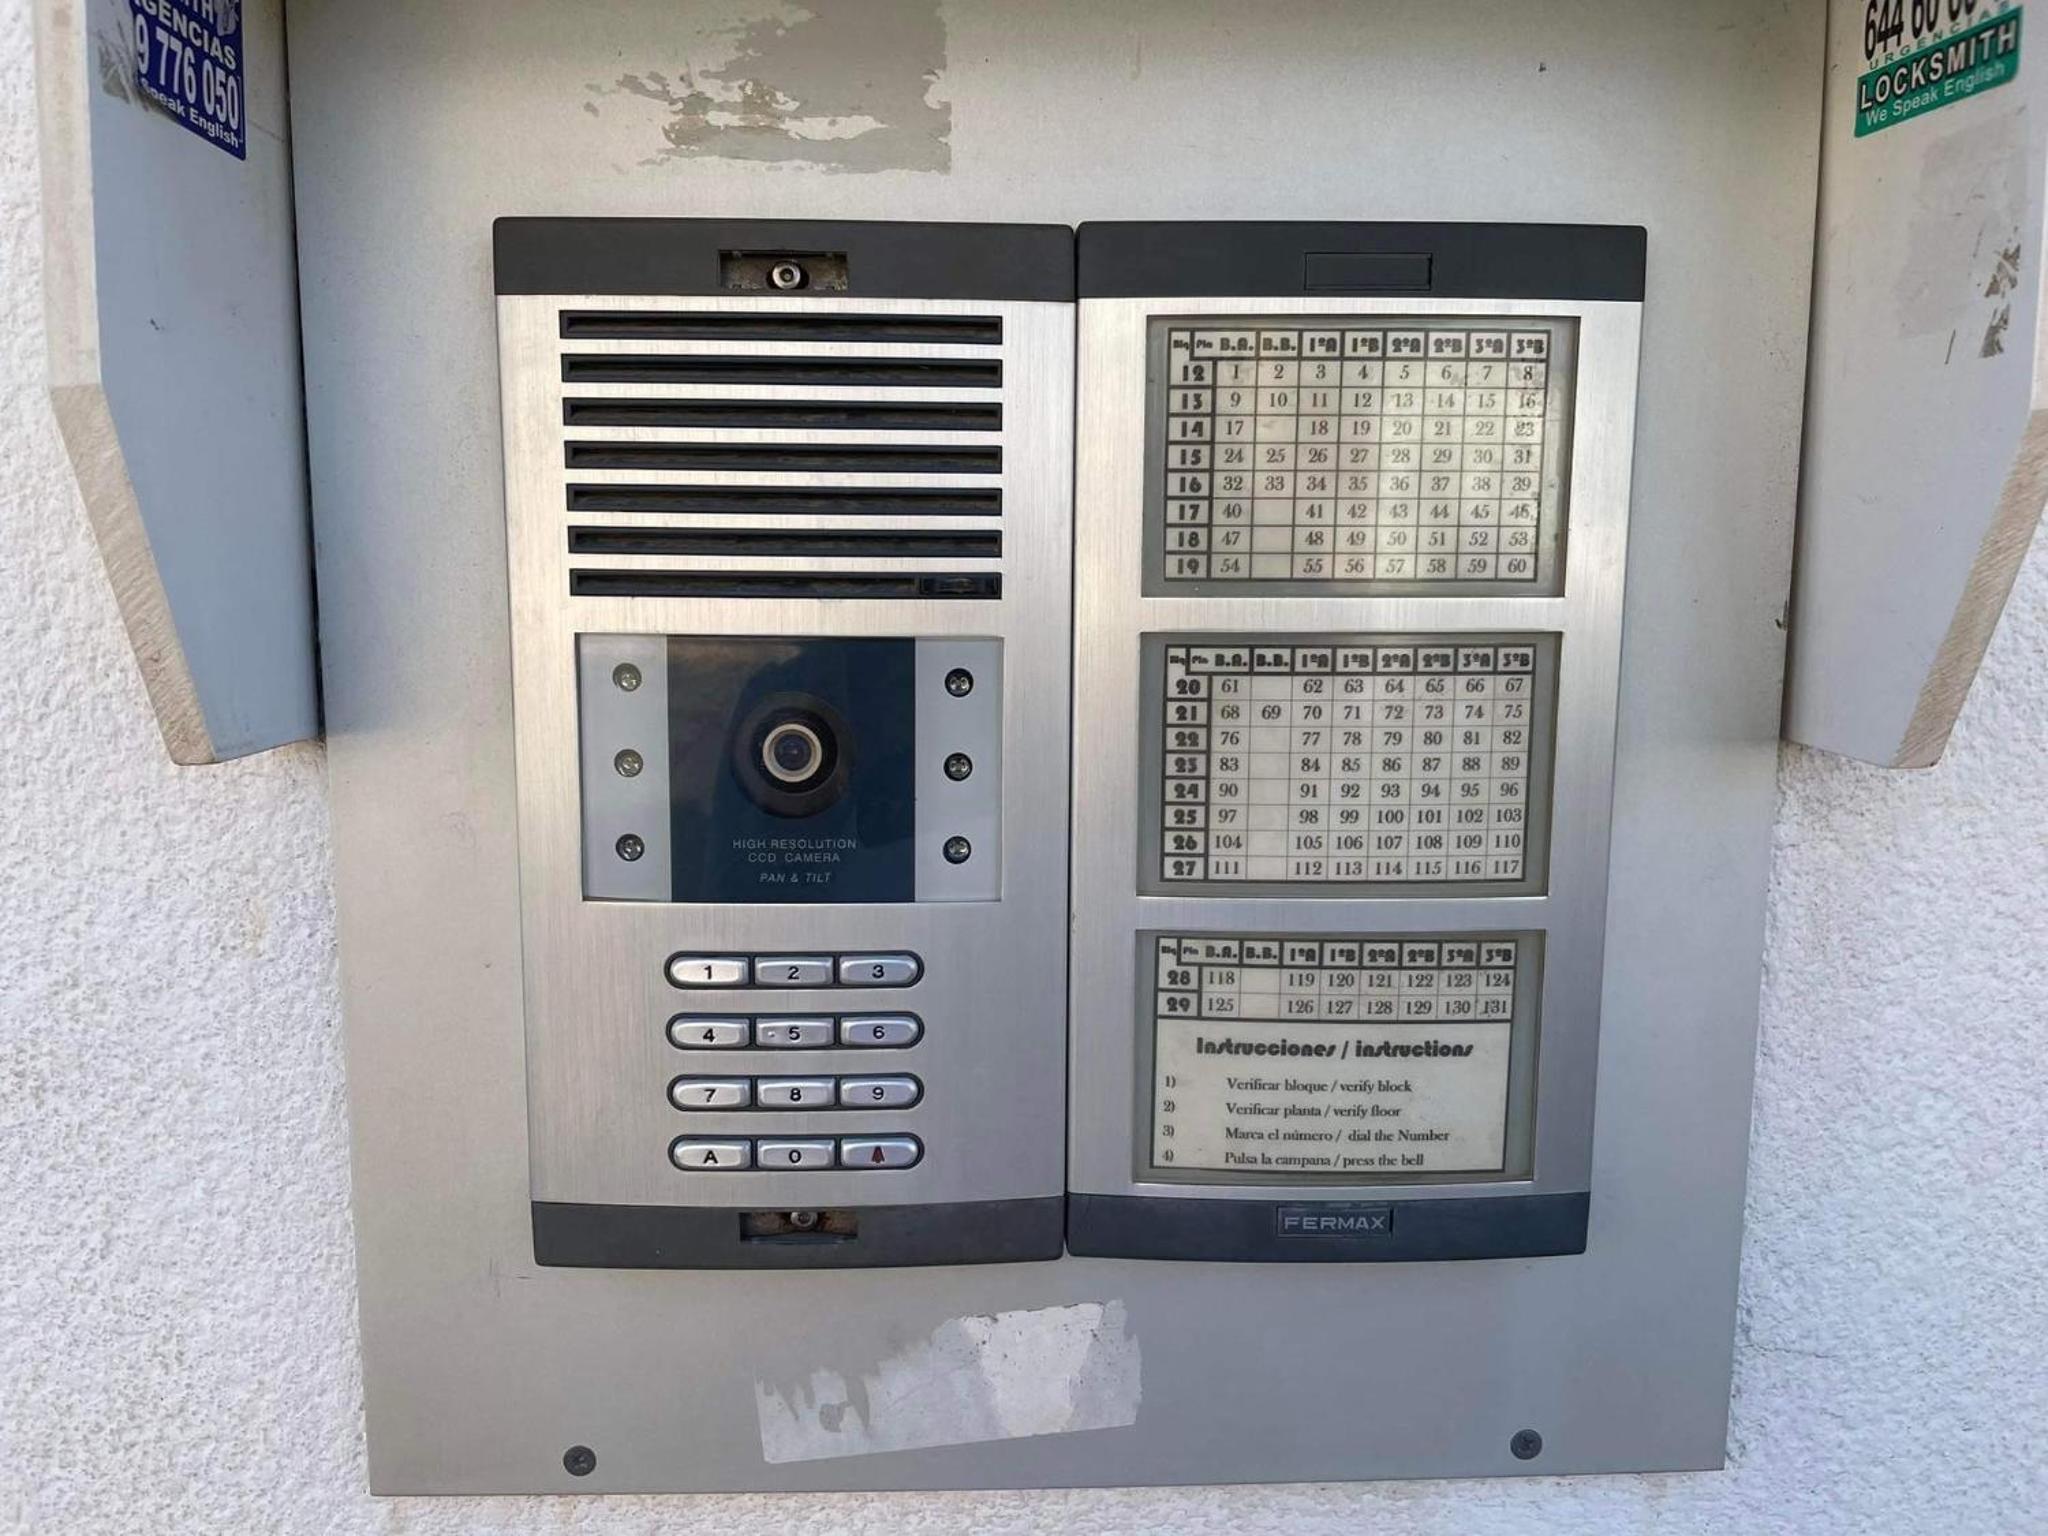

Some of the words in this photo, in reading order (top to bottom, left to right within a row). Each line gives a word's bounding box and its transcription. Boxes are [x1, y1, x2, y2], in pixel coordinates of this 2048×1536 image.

[136, 0, 236, 70] GENCIAS
[1860, 18, 2018, 110] LOCKSMITH
[155, 26, 197, 103] 776
[202, 60, 240, 131] 050
[1866, 109, 1888, 127] We
[1892, 90, 1939, 117] Speak
[1943, 61, 2006, 97] English
[190, 110, 239, 149] English
[1180, 448, 1202, 466] 15
[1223, 447, 1245, 464] 24
[1266, 447, 1286, 464] 25
[1308, 447, 1328, 464] 26
[1349, 447, 1369, 464] 27
[1391, 447, 1411, 464] 28
[1431, 447, 1453, 464] 29
[1513, 448, 1533, 465] 31
[1179, 476, 1203, 494] 16
[1222, 475, 1244, 491] 32
[1264, 475, 1285, 491] 33
[1306, 475, 1327, 491] 34
[1347, 475, 1369, 492] 35
[1389, 475, 1411, 492] 36
[1430, 475, 1451, 492] 37
[1177, 557, 1200, 575] 19
[1219, 557, 1241, 573] 54
[1302, 557, 1323, 574] 55
[1344, 557, 1365, 574] 56
[1385, 558, 1406, 575] 57
[1426, 557, 1447, 574] 58
[1467, 558, 1488, 574] 59
[1507, 557, 1527, 574] 60
[1175, 678, 1201, 696] 20
[1221, 678, 1239, 693] 61
[1303, 678, 1324, 694] 62
[1343, 677, 1364, 694] 63
[1384, 677, 1405, 694] 64
[1425, 677, 1445, 694] 65
[1465, 677, 1485, 693] 66
[1505, 677, 1524, 693] 67
[1175, 705, 1197, 722] 21
[1220, 703, 1241, 720] 68
[1261, 704, 1282, 720] 69
[1303, 705, 1323, 720] 70
[1343, 705, 1361, 721] 71
[1384, 704, 1405, 720] 72
[1424, 704, 1444, 720] 73
[1464, 704, 1485, 719] 74
[1504, 703, 1523, 719] 75
[1173, 808, 1197, 825] 25
[1218, 808, 1237, 824] 97
[1299, 809, 1319, 824] 98
[1339, 809, 1360, 825] 99
[1377, 809, 1405, 825] 100
[1417, 809, 1442, 824] 101
[1457, 808, 1484, 824] 102
[1496, 807, 1523, 823] 103
[732, 839, 766, 849] HIGH
[770, 839, 857, 849] RESOLUTION
[1172, 834, 1198, 851] 26
[1215, 834, 1243, 849] 104
[1295, 835, 1323, 850] 105
[1336, 835, 1364, 850] 106
[1377, 835, 1403, 850] 107
[1416, 834, 1443, 850] 108
[1456, 834, 1483, 849] 109
[1495, 833, 1521, 849] 110
[748, 852, 777, 863] CCD
[784, 852, 841, 863] CAMERA
[1172, 859, 1197, 877] 27
[1214, 860, 1239, 875] 111
[1295, 860, 1323, 876] 112
[1335, 861, 1363, 876] 113
[1375, 861, 1403, 876] 114
[1415, 861, 1442, 876] 115
[1455, 860, 1481, 875] 116
[1493, 859, 1520, 875] 117
[759, 872, 786, 883] PAN
[806, 872, 831, 883] TILT
[703, 965, 713, 980] 1
[787, 966, 800, 980] 2
[872, 965, 885, 979] 3
[1167, 969, 1191, 986] 28
[1209, 970, 1235, 985] 118
[1289, 972, 1316, 987] 119
[1328, 972, 1355, 988] 120
[1368, 973, 1392, 989] 121
[1407, 973, 1435, 988] 122
[1447, 973, 1473, 988] 123
[1485, 973, 1511, 987] 124
[1166, 996, 1191, 1013] 29
[1207, 997, 1234, 1013] 125
[1287, 999, 1314, 1015] 126
[1327, 999, 1353, 1015] 127
[1367, 1000, 1393, 1015] 128
[1406, 1000, 1433, 1015] 129
[1445, 1000, 1472, 1015] 130
[702, 1028, 715, 1043] 4
[789, 1027, 800, 1041] 5
[873, 1026, 885, 1039] 6
[1196, 1037, 1336, 1057] Instrucciones
[1341, 1040, 1349, 1060] /
[1355, 1040, 1474, 1057] instructions
[704, 1089, 716, 1103] 7
[790, 1088, 801, 1101] 8
[872, 1086, 884, 1100] 9
[1226, 1078, 1280, 1091] Verificar
[1284, 1078, 1328, 1094] bloque
[1340, 1080, 1374, 1094] verify
[1378, 1080, 1413, 1092] block
[1226, 1102, 1280, 1116] Verificar
[1283, 1104, 1321, 1119] planta
[1333, 1105, 1368, 1119] verify
[1371, 1104, 1401, 1117] floor
[1225, 1127, 1264, 1140] Marca
[1267, 1128, 1279, 1141] el
[1348, 1129, 1371, 1142] dial
[1374, 1129, 1393, 1142] the
[1398, 1129, 1450, 1142] Number
[703, 1150, 719, 1164] A
[1225, 1151, 1258, 1164] Pulsa
[1261, 1152, 1272, 1165] la
[1275, 1155, 1331, 1168] campana
[1343, 1156, 1375, 1168] press
[1378, 1154, 1397, 1166] the
[1401, 1153, 1424, 1166] bell
[1284, 1216, 1385, 1230] FERMAX
